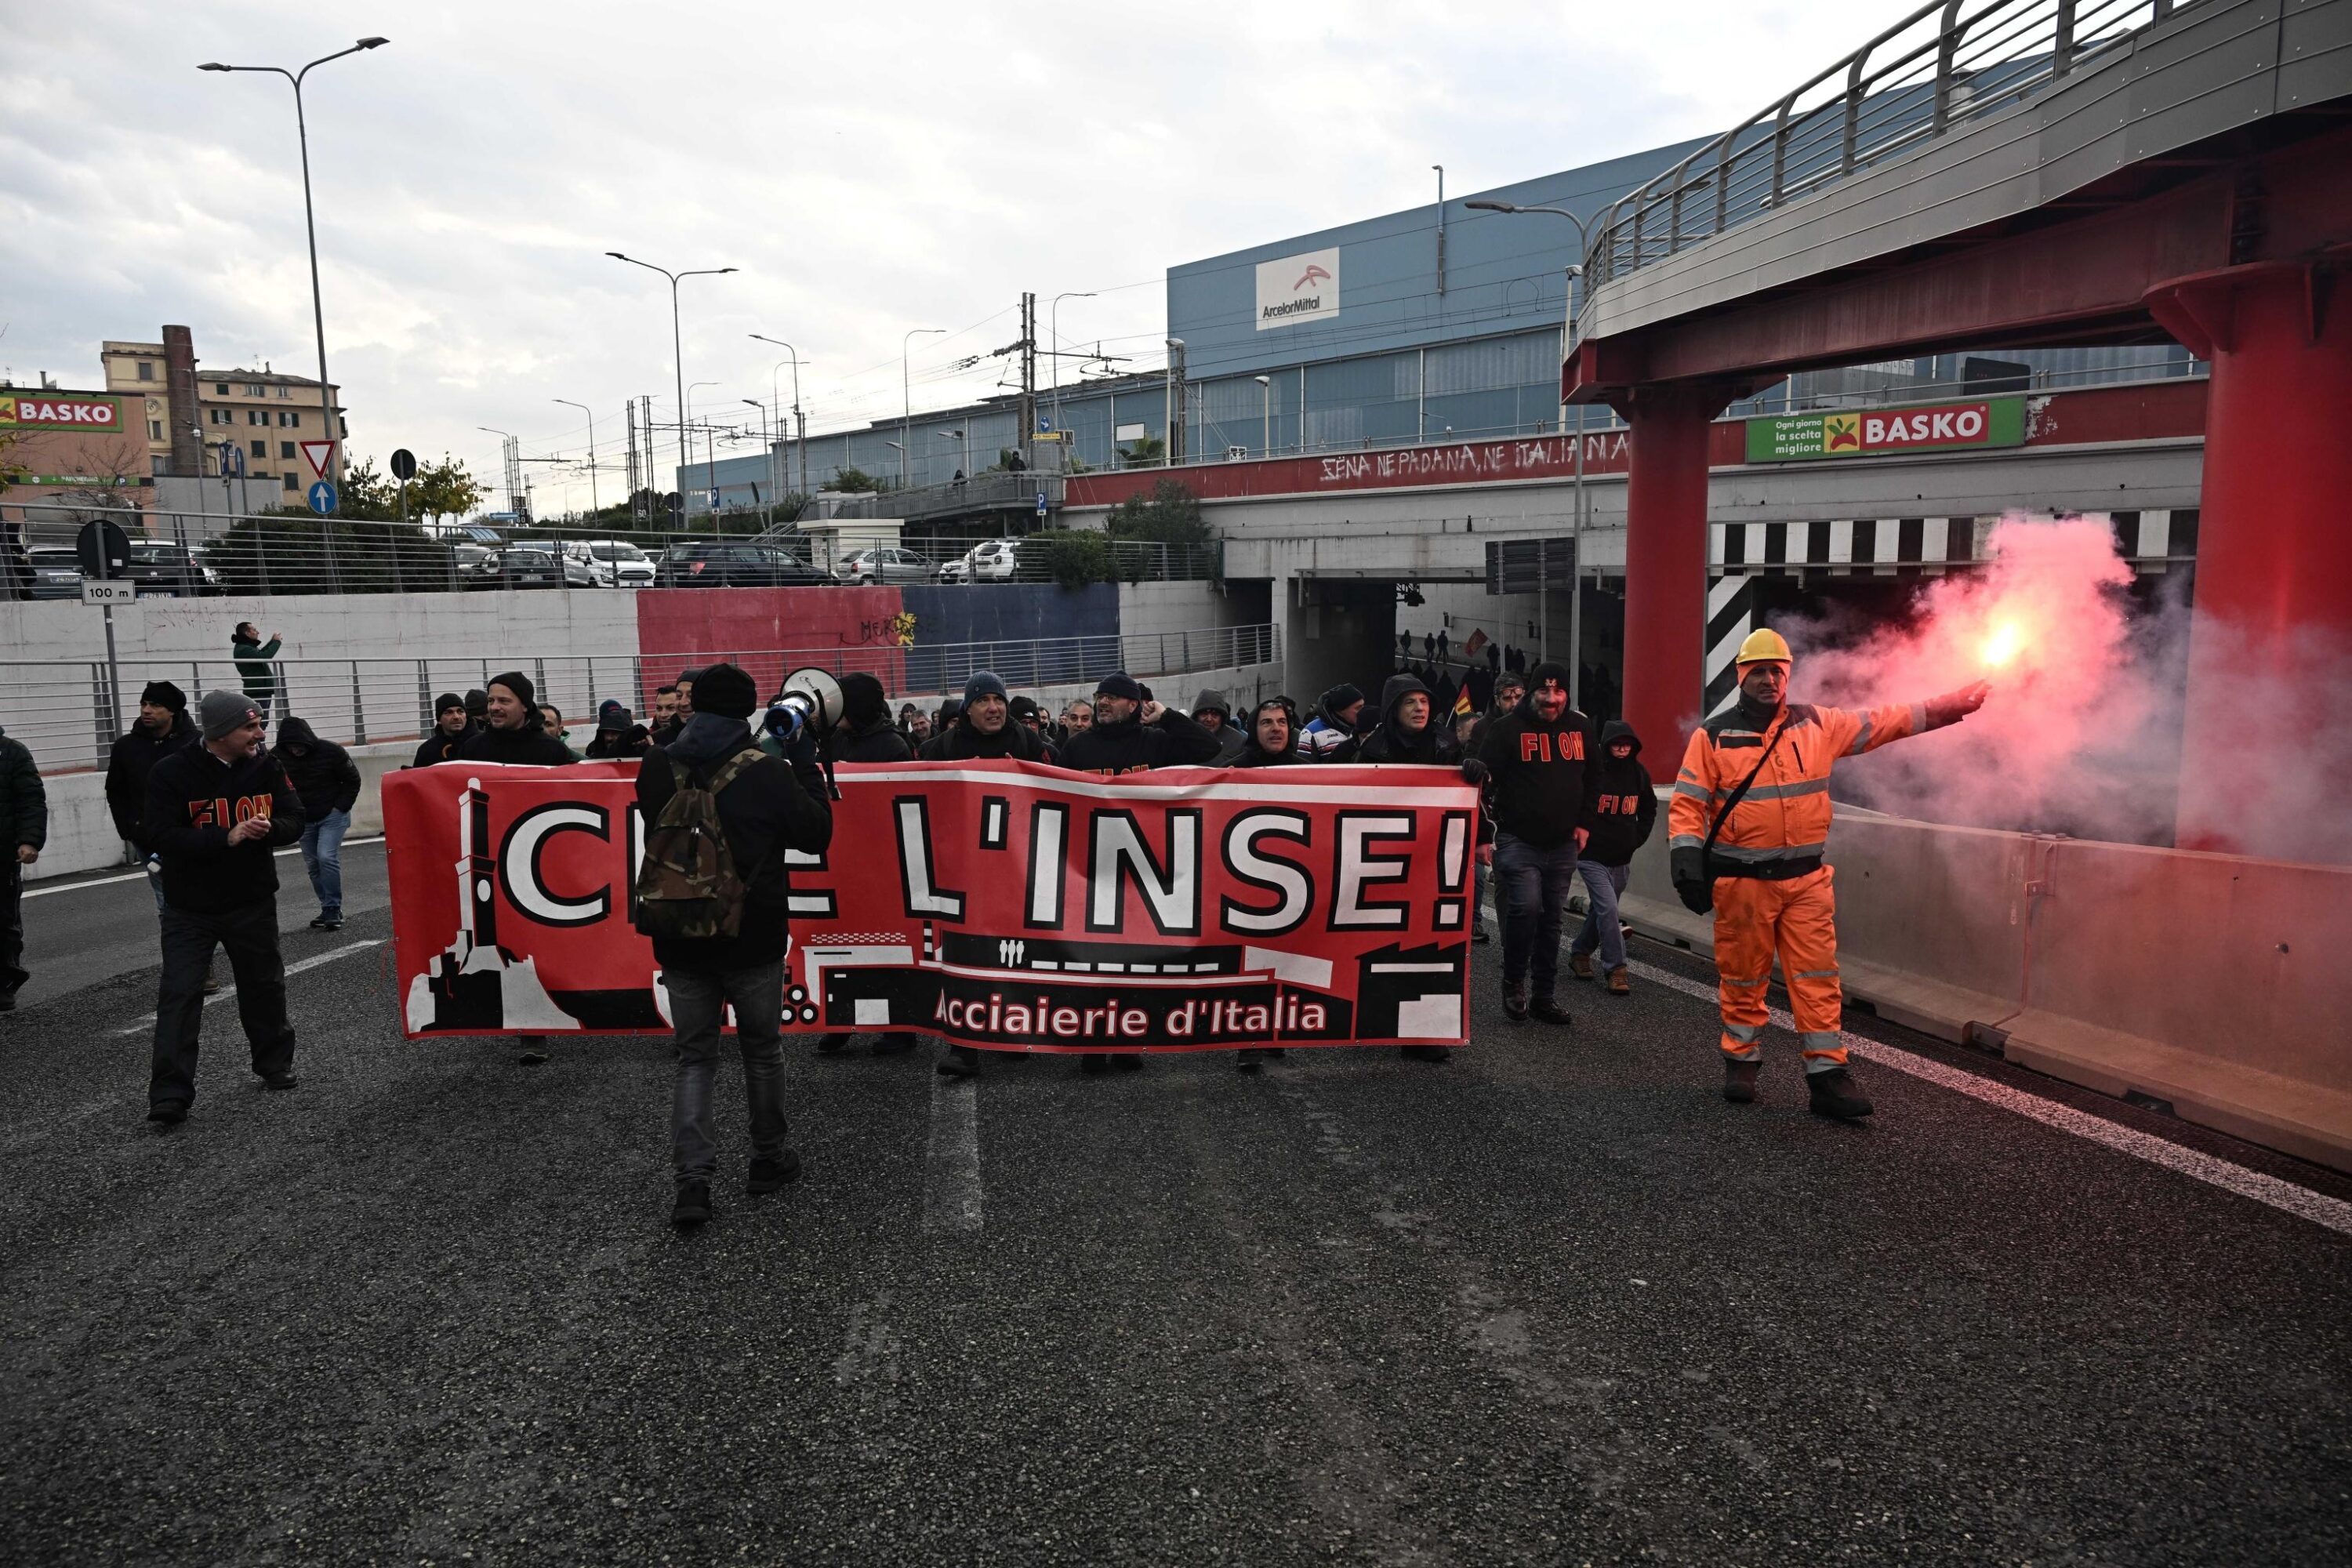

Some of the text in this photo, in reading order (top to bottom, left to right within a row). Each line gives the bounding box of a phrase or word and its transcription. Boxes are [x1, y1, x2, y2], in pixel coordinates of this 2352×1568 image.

[1263, 296, 1320, 318] ArcelorMittal
[20, 402, 112, 423] BASKO
[1776, 419, 1822, 430] Ogni giorno
[1866, 411, 1982, 444] BASKO
[1776, 430, 1821, 441] la scelta
[1775, 443, 1821, 456] migliore
[713, 488, 718, 506] P
[1038, 493, 1044, 508] P
[89, 588, 112, 597] 100
[892, 793, 1469, 937] L'INSE!
[935, 986, 1327, 1037] Acciaierie d'Italia
